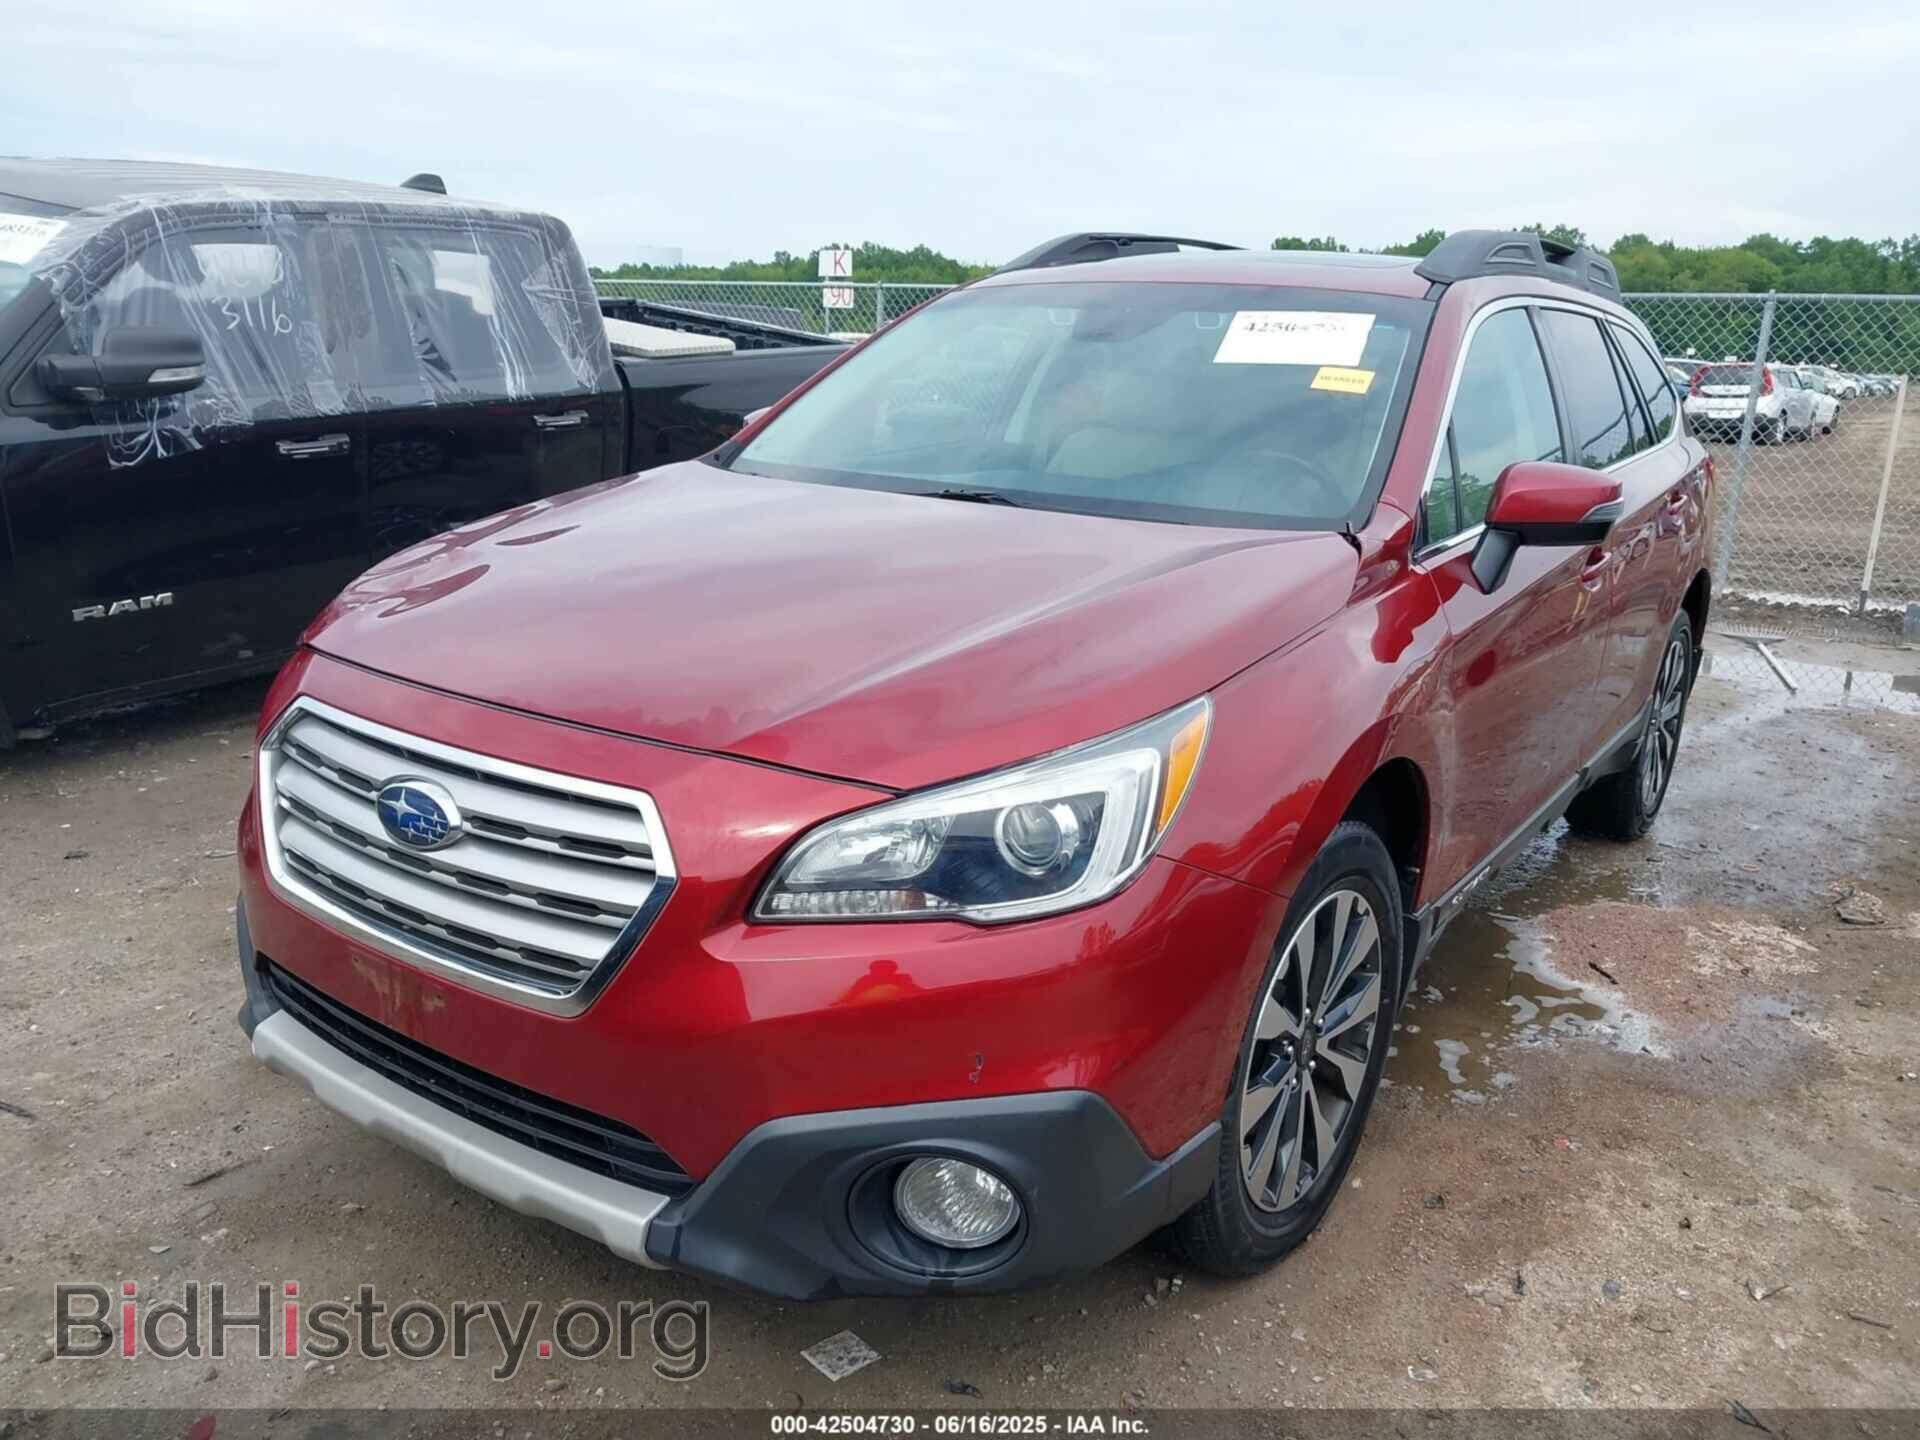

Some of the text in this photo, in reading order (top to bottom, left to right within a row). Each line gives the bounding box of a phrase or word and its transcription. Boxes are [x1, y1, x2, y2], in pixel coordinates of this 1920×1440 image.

[833, 250, 847, 275] K
[831, 287, 853, 306] 90
[71, 592, 173, 621] RAM
